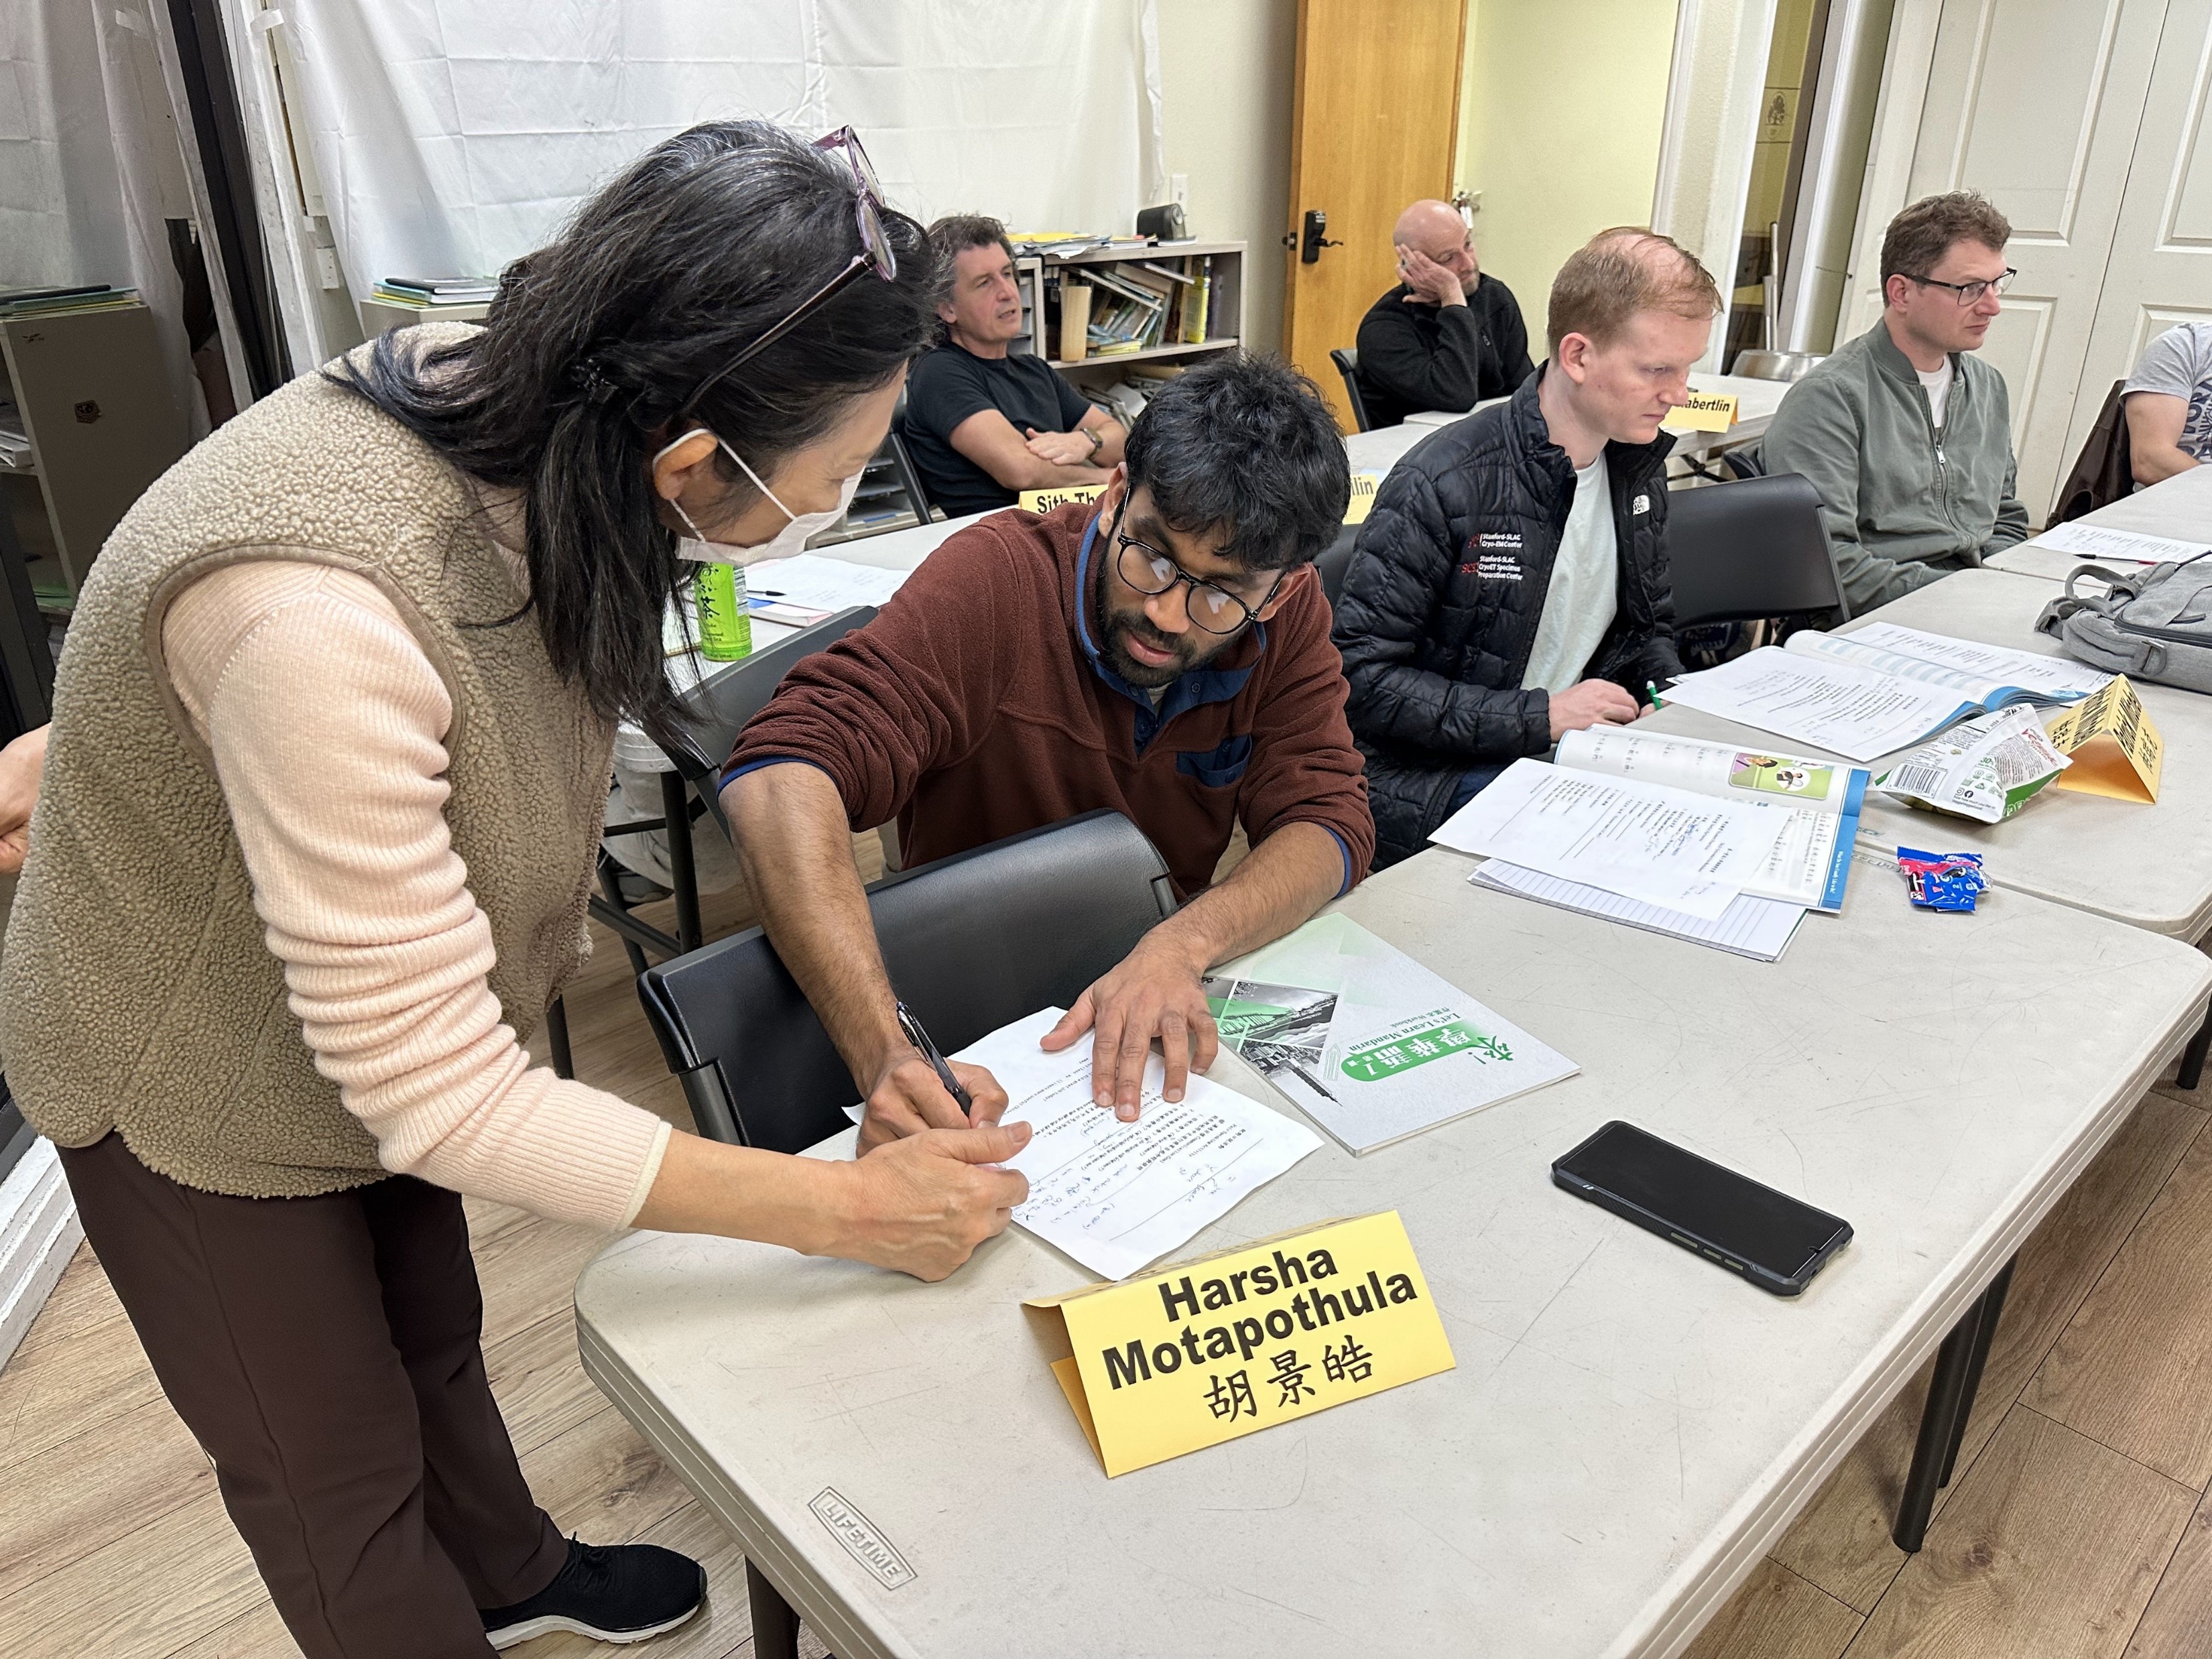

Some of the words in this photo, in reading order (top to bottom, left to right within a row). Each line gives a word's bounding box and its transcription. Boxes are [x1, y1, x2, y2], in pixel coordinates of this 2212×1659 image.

[1682, 397, 1730, 412] abertlin
[1483, 532, 1521, 541] Stanford-SLAC
[1481, 540, 1503, 548] Cryo-EM
[1479, 554, 1515, 563] Stanford-SLAC
[1497, 564, 1521, 572] Specimen
[1506, 572, 1523, 580] Center
[1390, 1014, 1426, 1028] Workbook
[1434, 1013, 1461, 1024] Let's
[1402, 1020, 1434, 1034] Learn
[1349, 1030, 1403, 1051] Mandarin
[1158, 1249, 1339, 1323] Harsha
[1101, 1270, 1418, 1390] Motapothula
[1203, 1335, 1373, 1423] 胡景皓
[822, 1500, 902, 1579] LIFETIME
